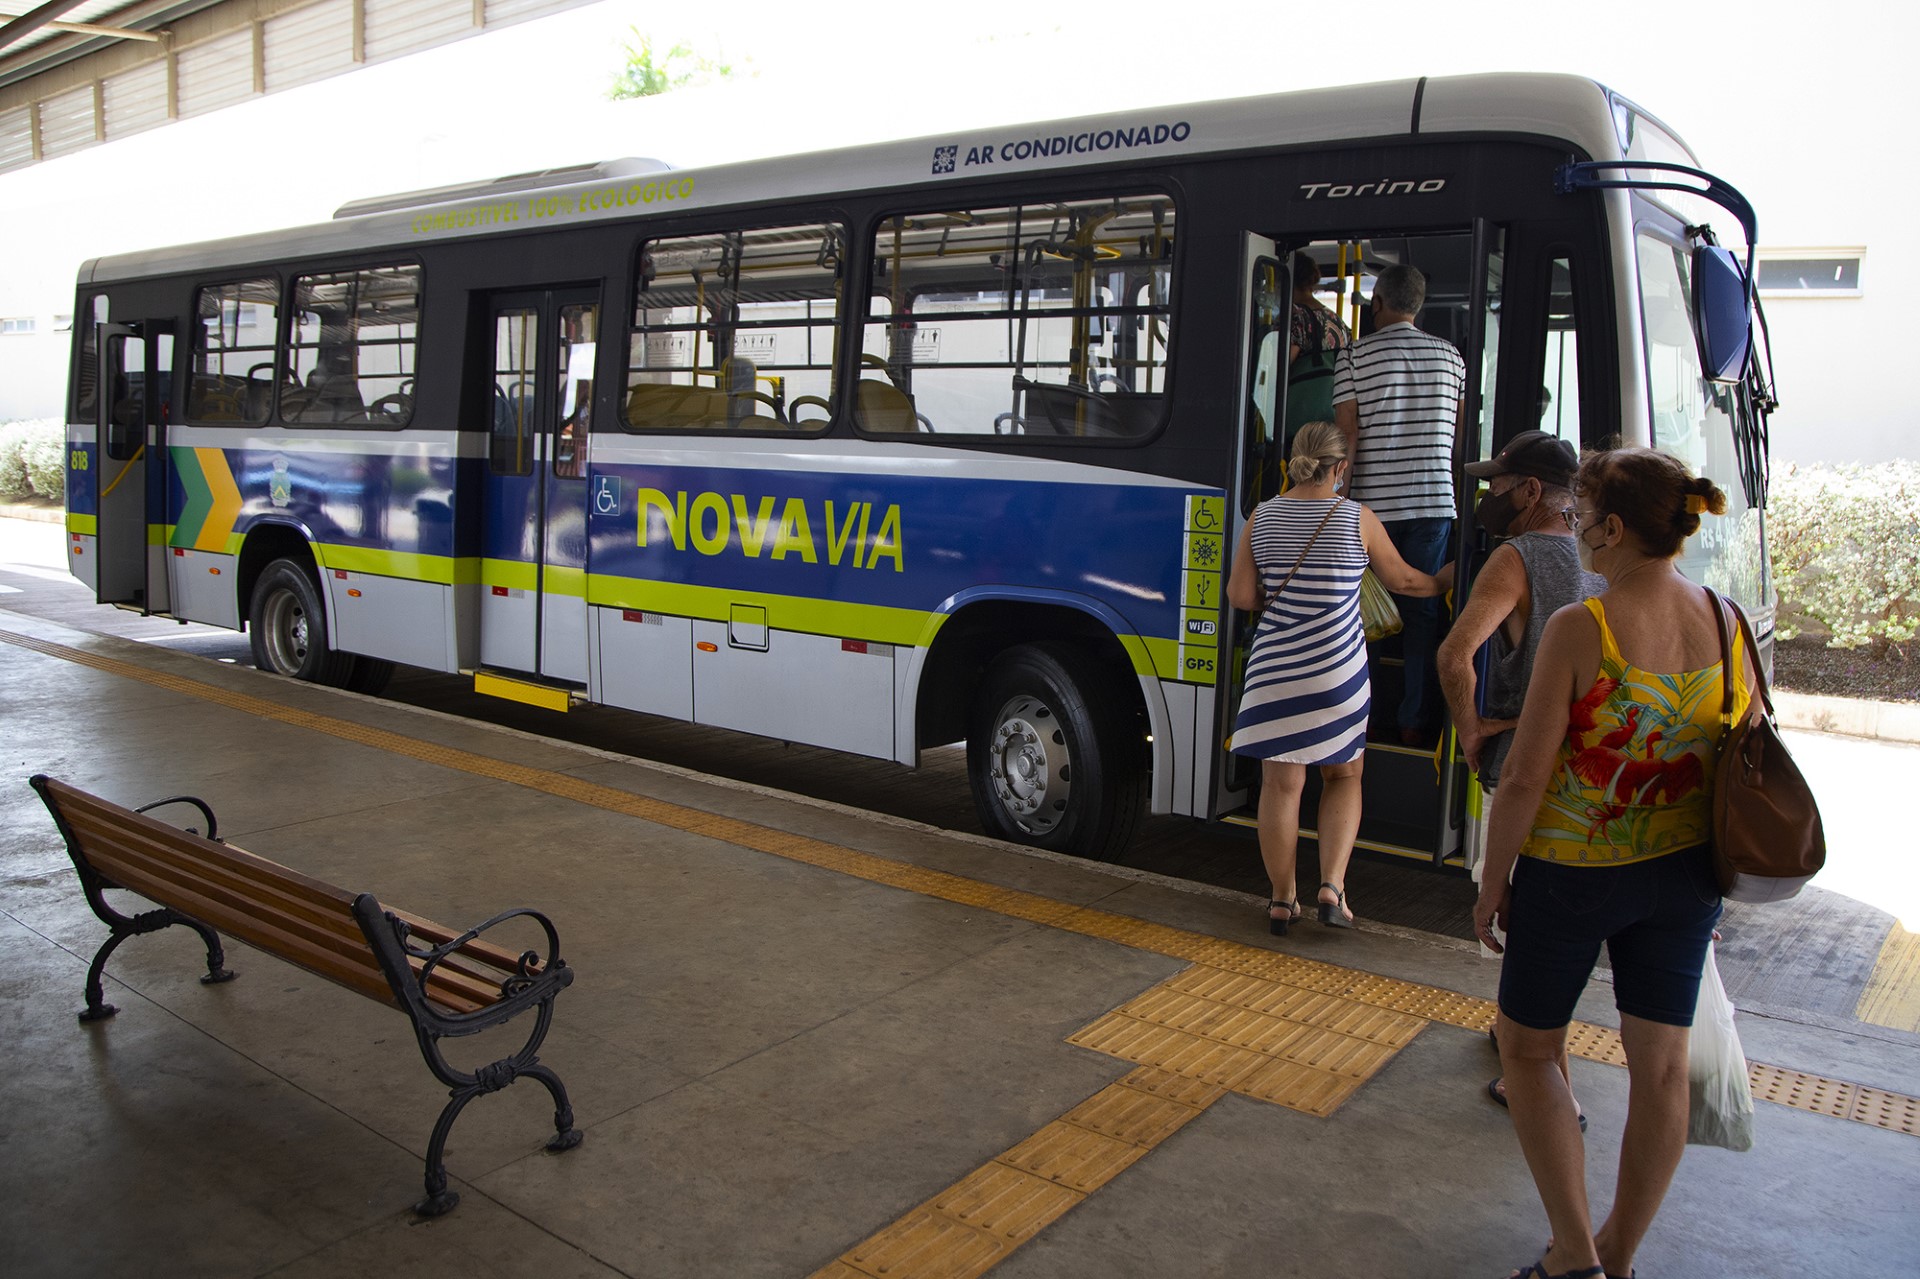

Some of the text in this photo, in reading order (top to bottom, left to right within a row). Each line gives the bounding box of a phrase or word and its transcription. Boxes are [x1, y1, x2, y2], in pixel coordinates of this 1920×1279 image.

[964, 121, 1191, 166] AR CONDICIONADO
[1299, 178, 1446, 200] Torino
[70, 450, 89, 471] 818
[636, 487, 904, 573] NOVA VIA
[1185, 657, 1214, 672] GPS
